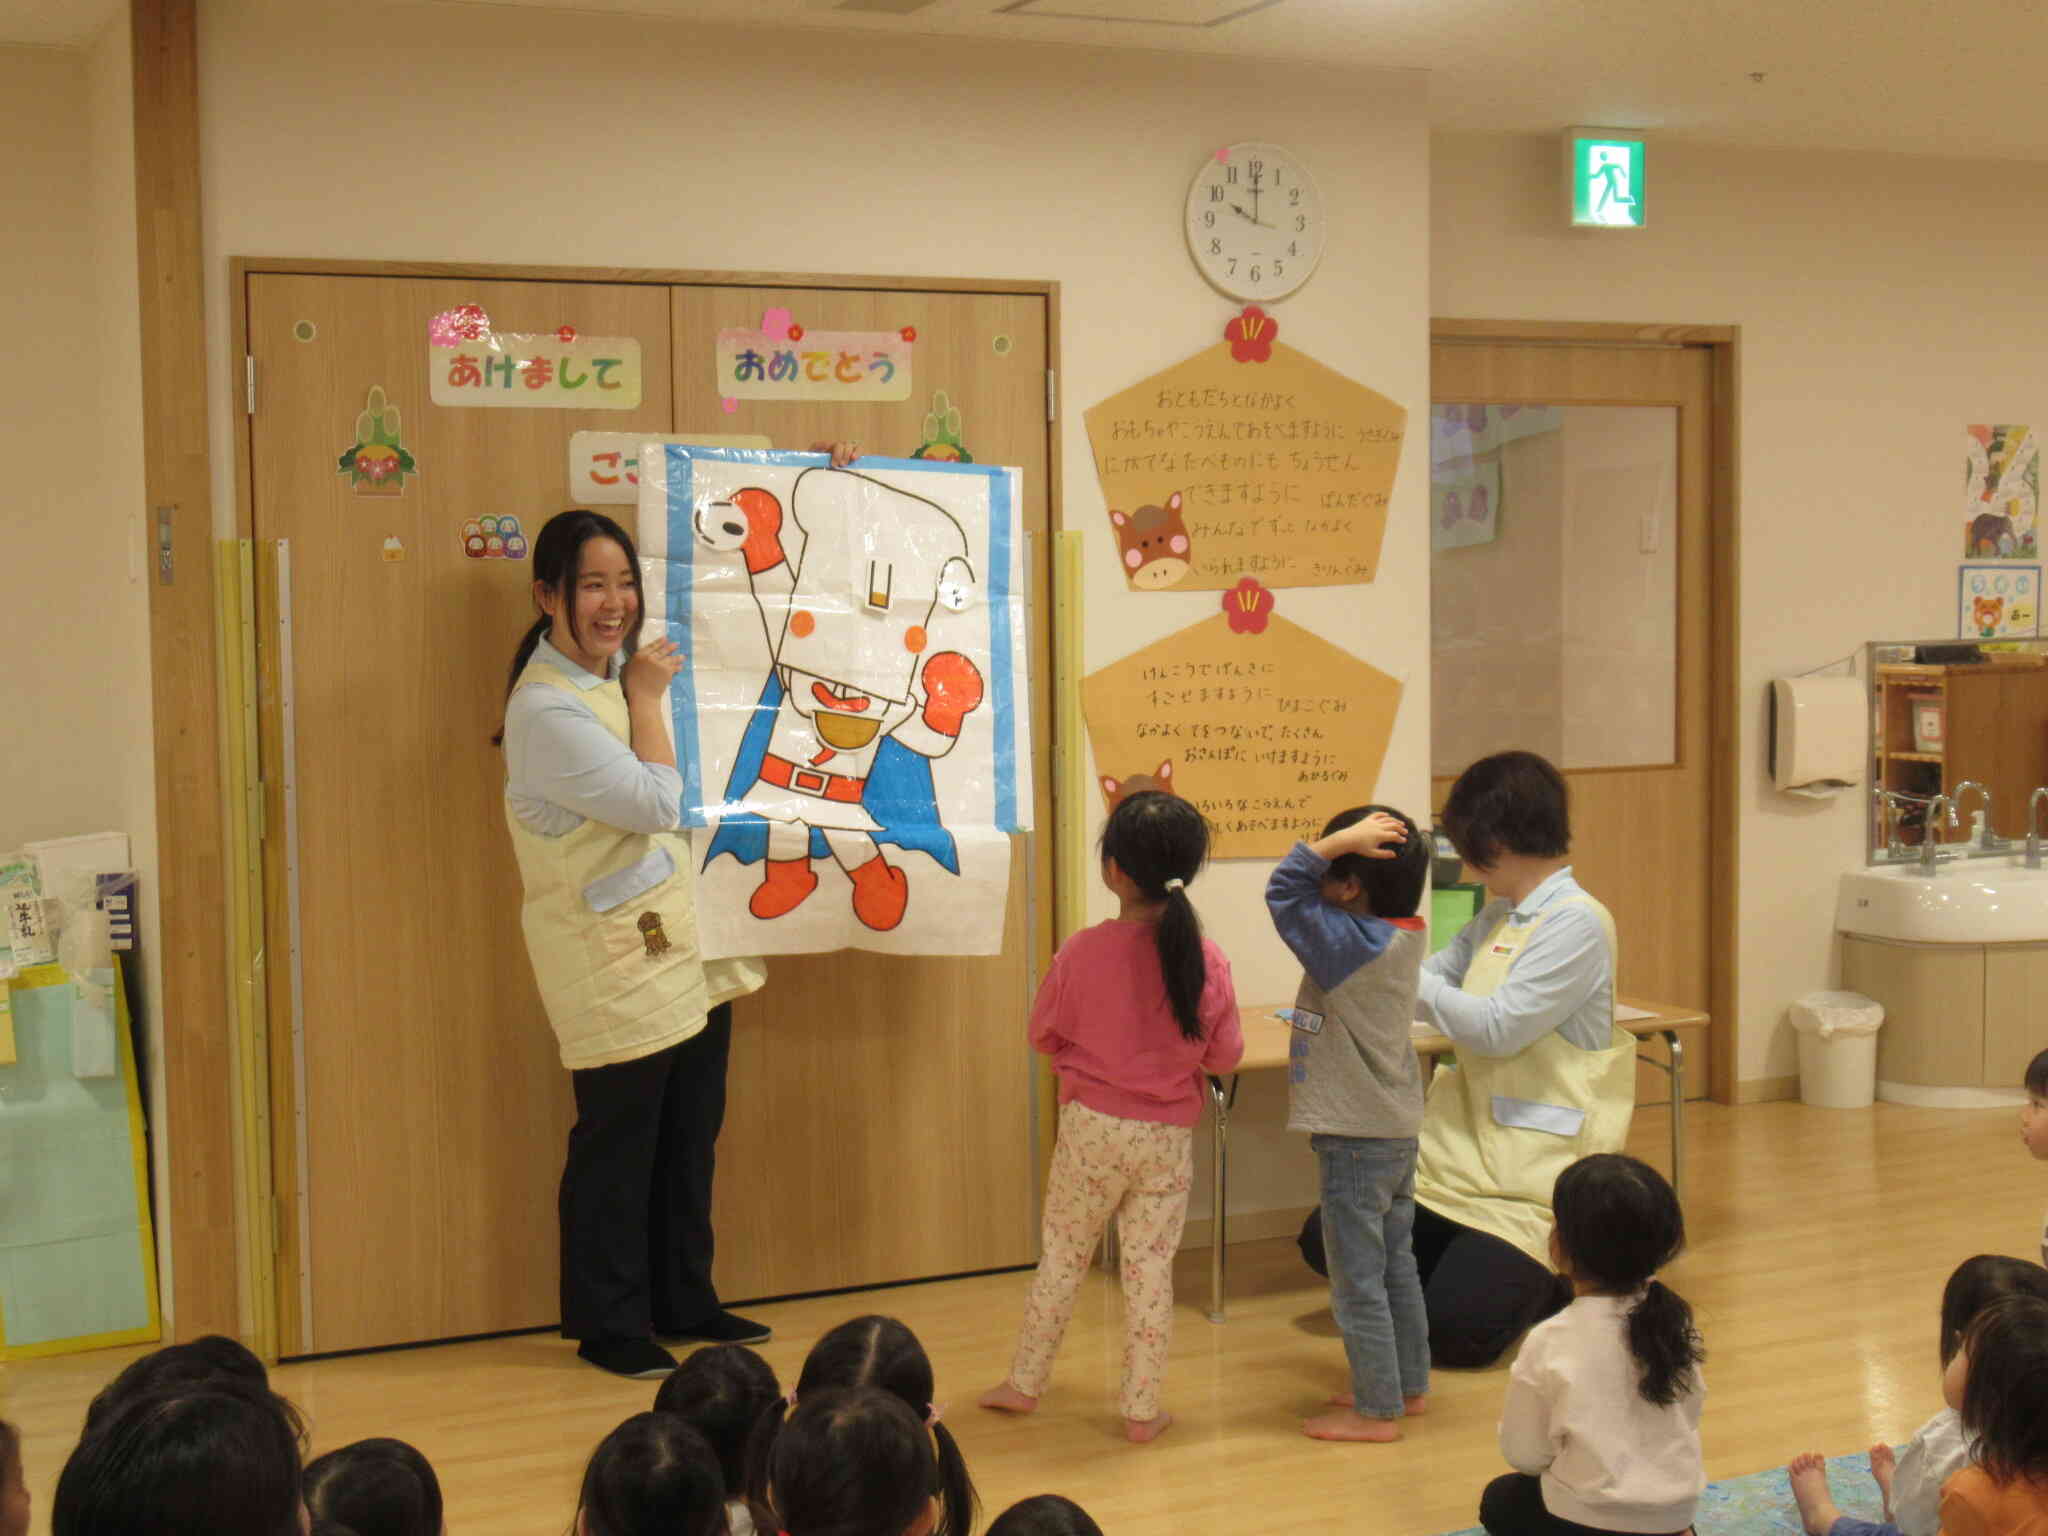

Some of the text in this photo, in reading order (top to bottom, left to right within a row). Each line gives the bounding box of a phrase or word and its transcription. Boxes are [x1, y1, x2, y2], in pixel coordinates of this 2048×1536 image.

[1227, 166, 1238, 184] 11
[1274, 168, 1281, 186] 1
[1210, 184, 1224, 202] 10
[1289, 188, 1299, 206] 2
[1205, 210, 1215, 228] 9
[1295, 214, 1305, 232] 3
[1211, 238, 1222, 255] 8
[1288, 240, 1297, 256] 4
[1227, 257, 1237, 275] 7
[1250, 265, 1261, 282] 6
[1274, 260, 1283, 276] 5
[447, 353, 624, 390] あけまして
[734, 349, 896, 384] おめでとう
[1212, 817, 1321, 833] しくあそべますように
